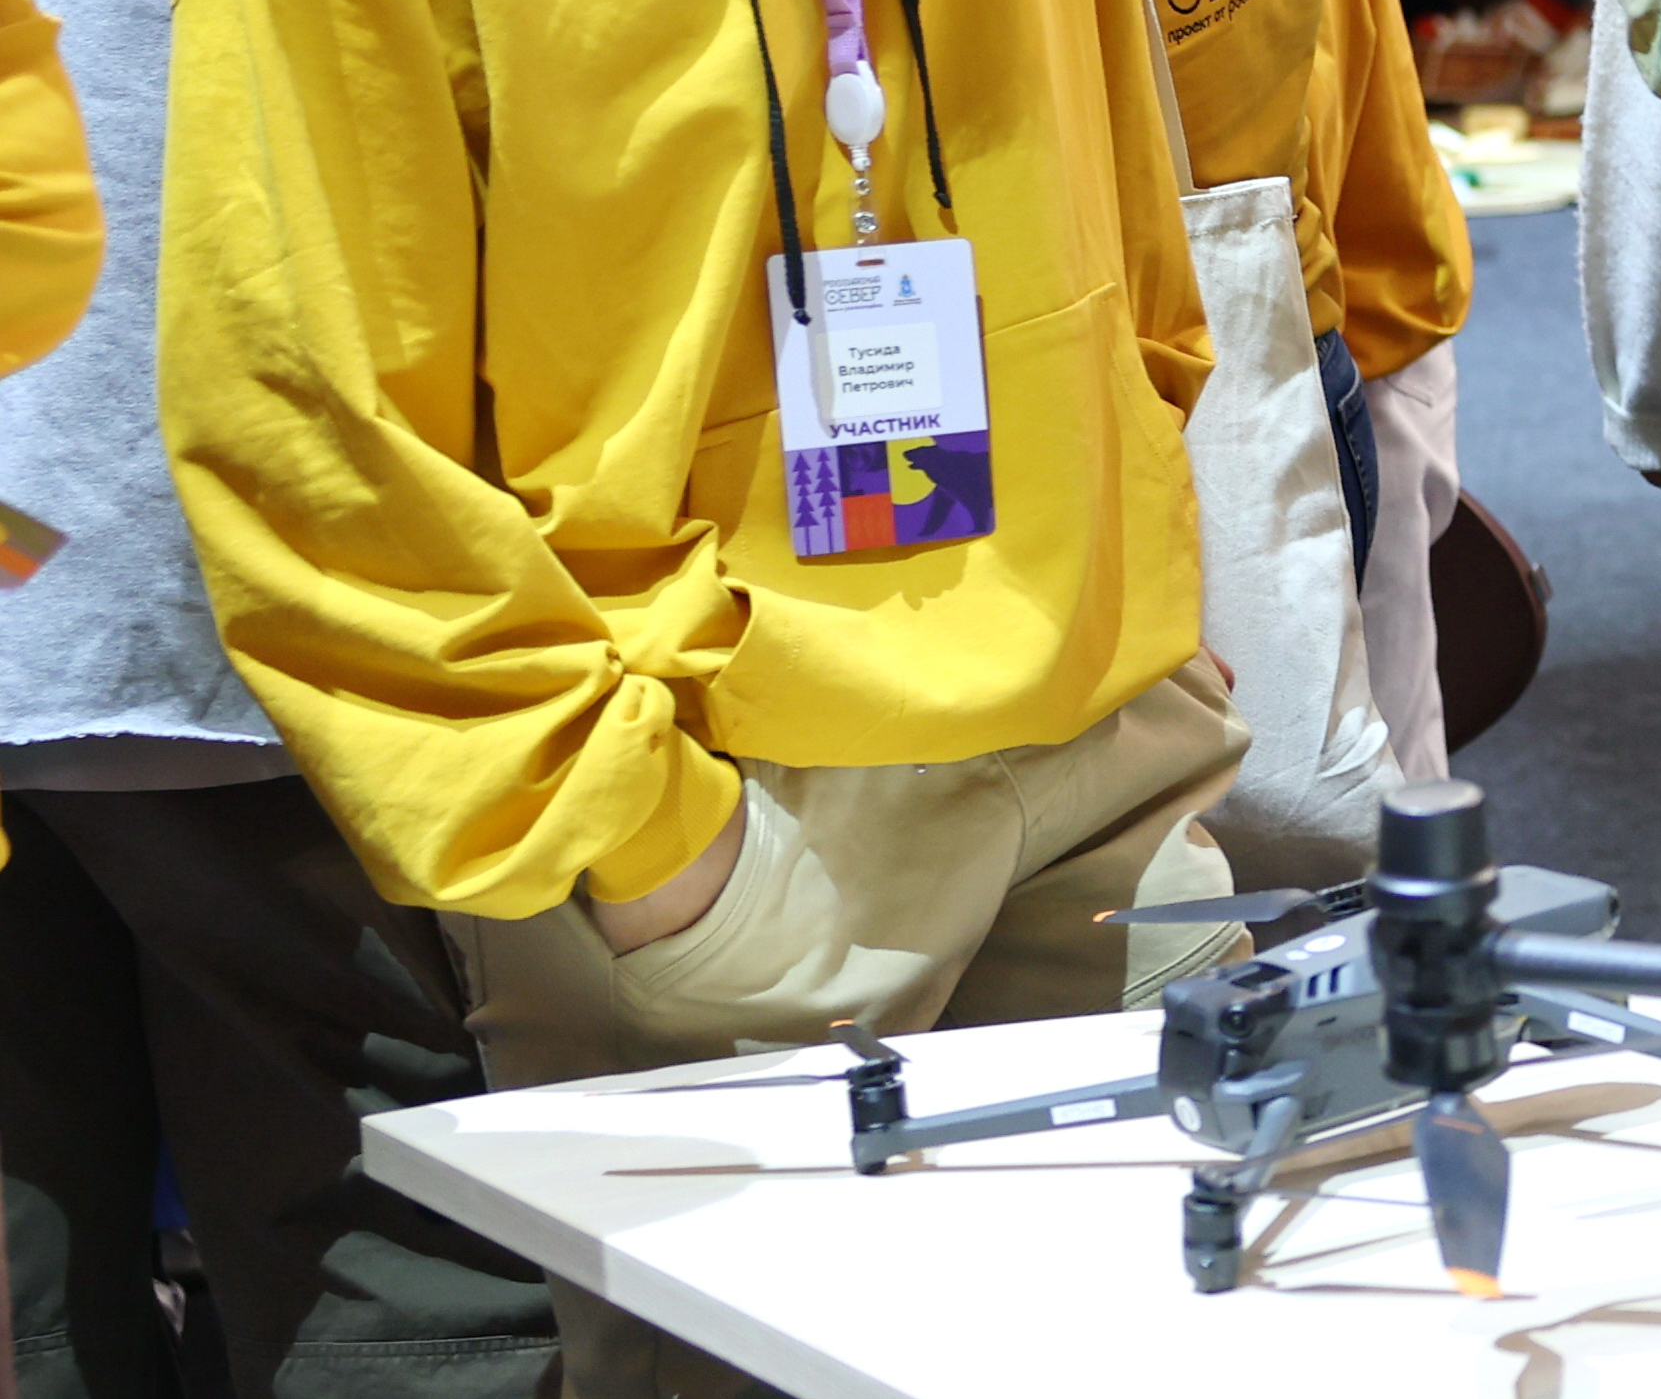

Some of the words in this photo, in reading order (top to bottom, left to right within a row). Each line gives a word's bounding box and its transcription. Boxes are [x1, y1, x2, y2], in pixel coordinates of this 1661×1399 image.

[1167, 14, 1211, 46] проект
[1214, 5, 1226, 22] от
[825, 285, 882, 305] СЕВЕР
[848, 345, 901, 360] Тусида
[838, 361, 915, 377] Владимир
[842, 379, 914, 393] Петрович
[829, 413, 941, 439] УЧАСТНИК
